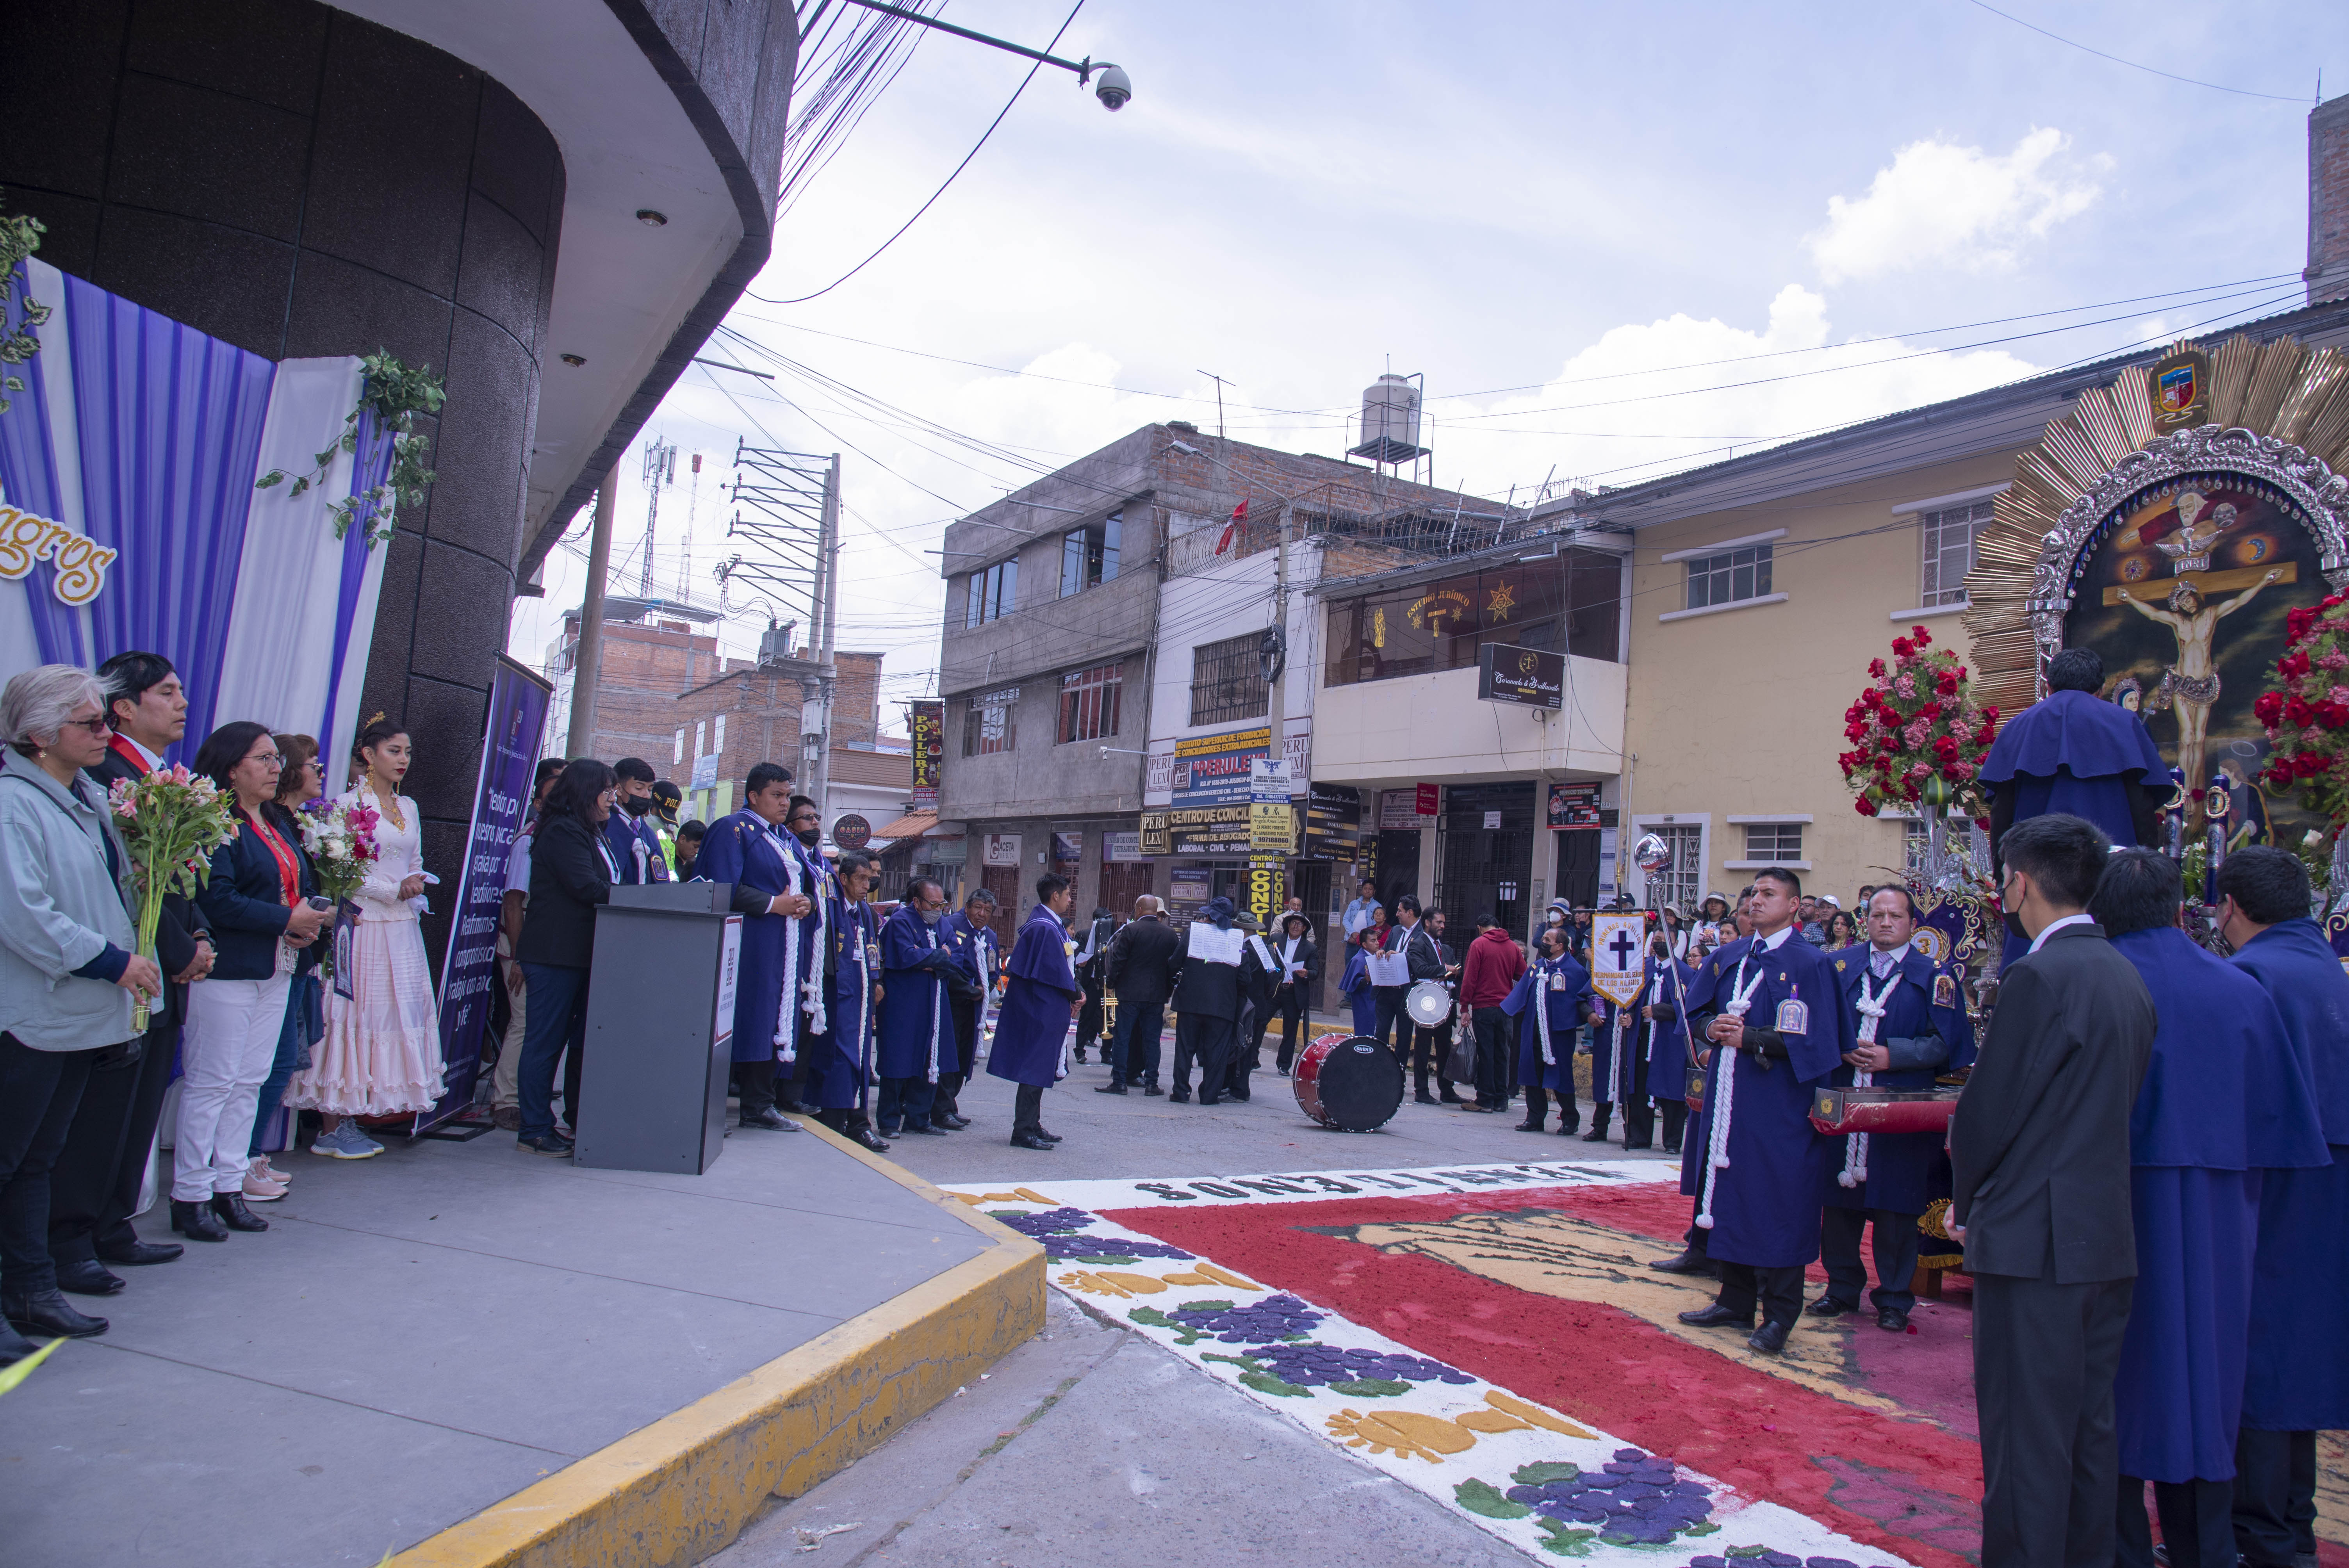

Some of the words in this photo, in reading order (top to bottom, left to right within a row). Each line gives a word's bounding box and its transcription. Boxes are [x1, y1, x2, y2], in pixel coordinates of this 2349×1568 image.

[2180, 559, 2204, 569] INRI
[1407, 593, 1435, 618] ESTUDIO
[1438, 589, 1469, 606] JURÍDICO
[1428, 609, 1447, 617] ABOGADOS
[1494, 671, 1523, 684] Coronado
[1176, 739, 1202, 749] INSTITUTO
[1202, 735, 1228, 746] SUPERIOR
[1228, 734, 1237, 742] DE
[1237, 728, 1270, 741] FORMACIÓN
[914, 716, 929, 785] POLLERÍA
[1182, 744, 1221, 757] CONCILIADORES
[1222, 738, 1271, 752] EXTRAJUDICIALES
[1151, 756, 1173, 770] PERU
[1175, 764, 1190, 775] PERU
[1153, 772, 1166, 785] LEX
[1310, 791, 1331, 801] Coronado
[1144, 816, 1168, 829] PERU
[1171, 809, 1203, 824] CENTRO
[1204, 808, 1217, 822] DE
[1146, 832, 1161, 845] LEX
[1210, 833, 1219, 841] DE
[991, 842, 1014, 859] GACETA
[1178, 844, 1205, 852] LABORAL
[1210, 843, 1225, 852] CIVIL
[1230, 843, 1251, 852] PENAL
[1623, 921, 1641, 945] AUXILIOS
